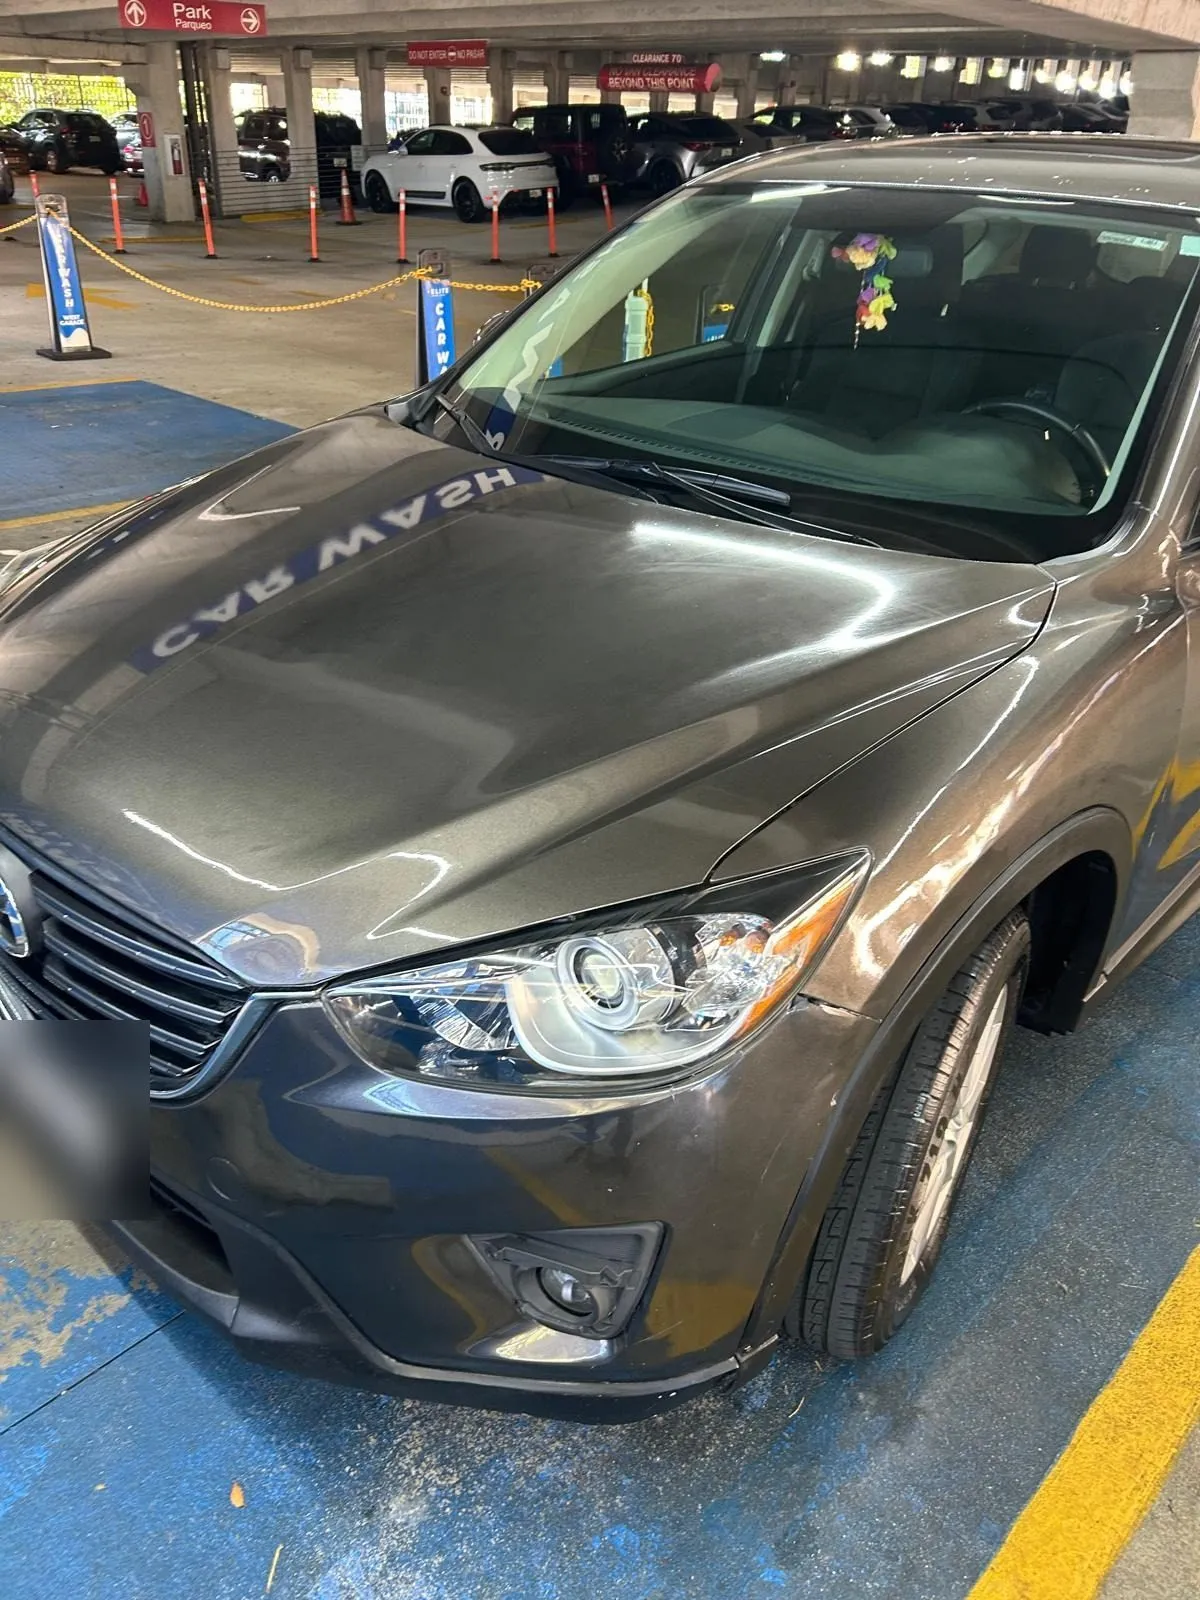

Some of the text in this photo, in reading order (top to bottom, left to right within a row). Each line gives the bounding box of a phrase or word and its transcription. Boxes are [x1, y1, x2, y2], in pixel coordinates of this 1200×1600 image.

[172, 2, 212, 20] Park
[175, 18, 212, 31] Parqueo
[408, 48, 485, 60] DO NOT ENTER NO PASAR
[632, 53, 670, 63] CLEARANCE
[608, 77, 695, 89] BEYOND THIS POINT
[435, 302, 447, 346] CAR
